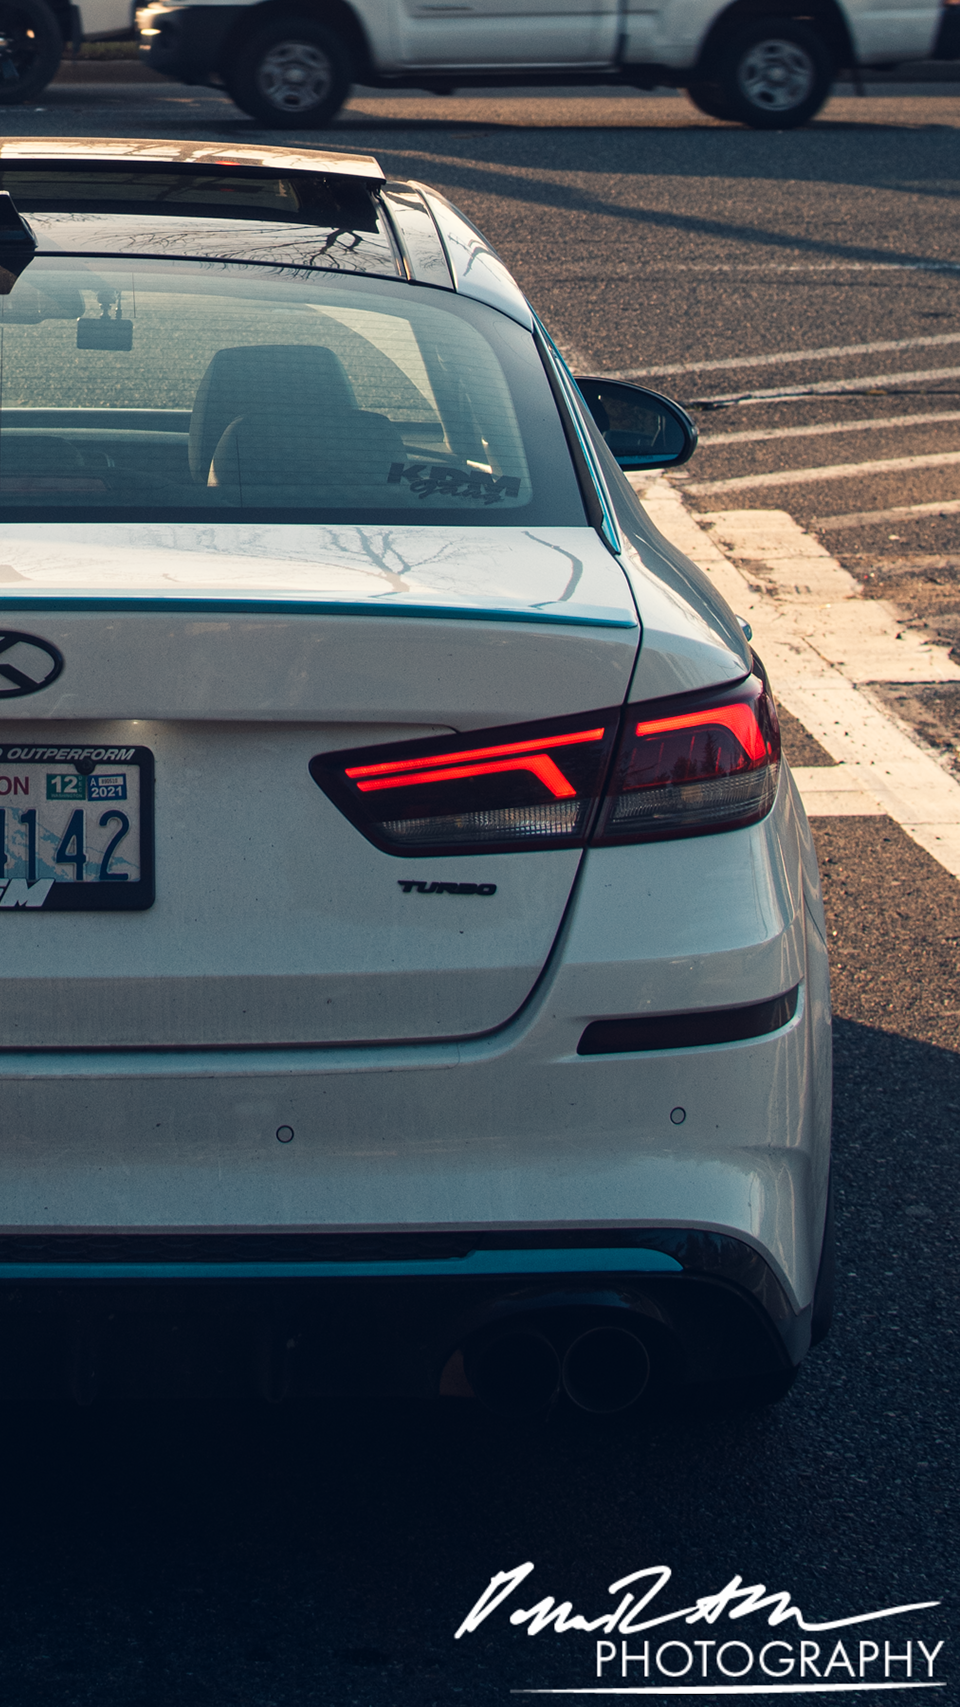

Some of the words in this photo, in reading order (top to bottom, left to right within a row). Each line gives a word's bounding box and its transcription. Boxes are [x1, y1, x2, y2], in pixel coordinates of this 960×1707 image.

[387, 462, 522, 498] KDM
[6, 748, 136, 761] OUTPERFORM
[51, 775, 78, 793] 12
[90, 778, 97, 787] A
[91, 786, 122, 798] 2021
[397, 879, 497, 896] TURBO
